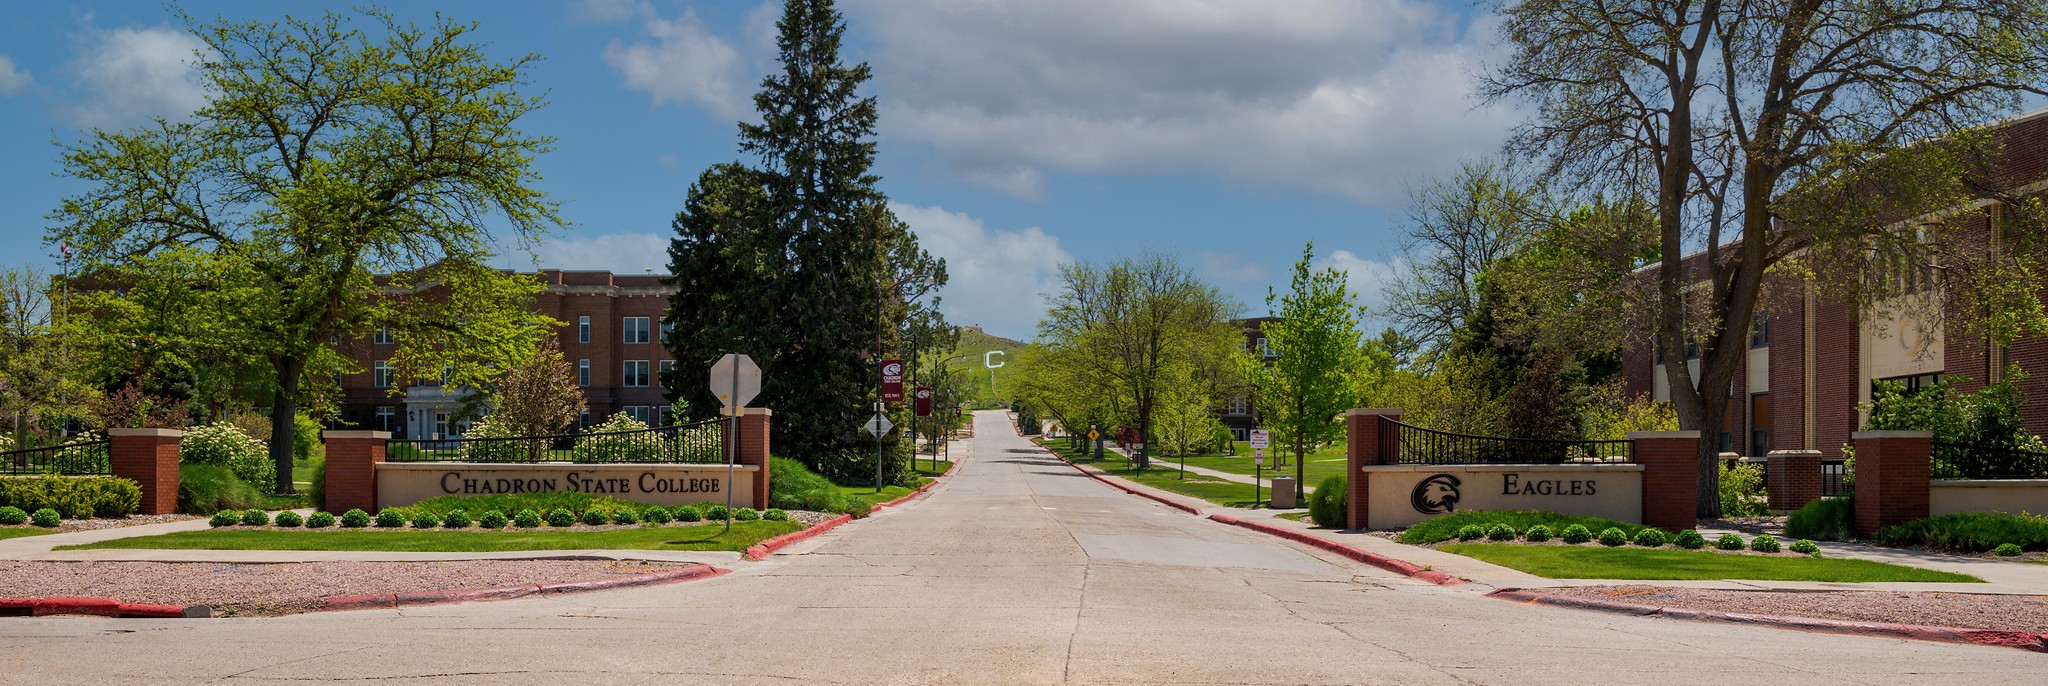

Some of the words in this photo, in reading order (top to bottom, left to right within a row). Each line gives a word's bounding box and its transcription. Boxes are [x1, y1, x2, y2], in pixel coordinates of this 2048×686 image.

[986, 350, 1005, 368] C
[440, 472, 556, 494] CHADRON
[566, 472, 631, 494] STATE
[638, 472, 720, 493] COLLEGE
[1501, 473, 1596, 496] EAGLES
